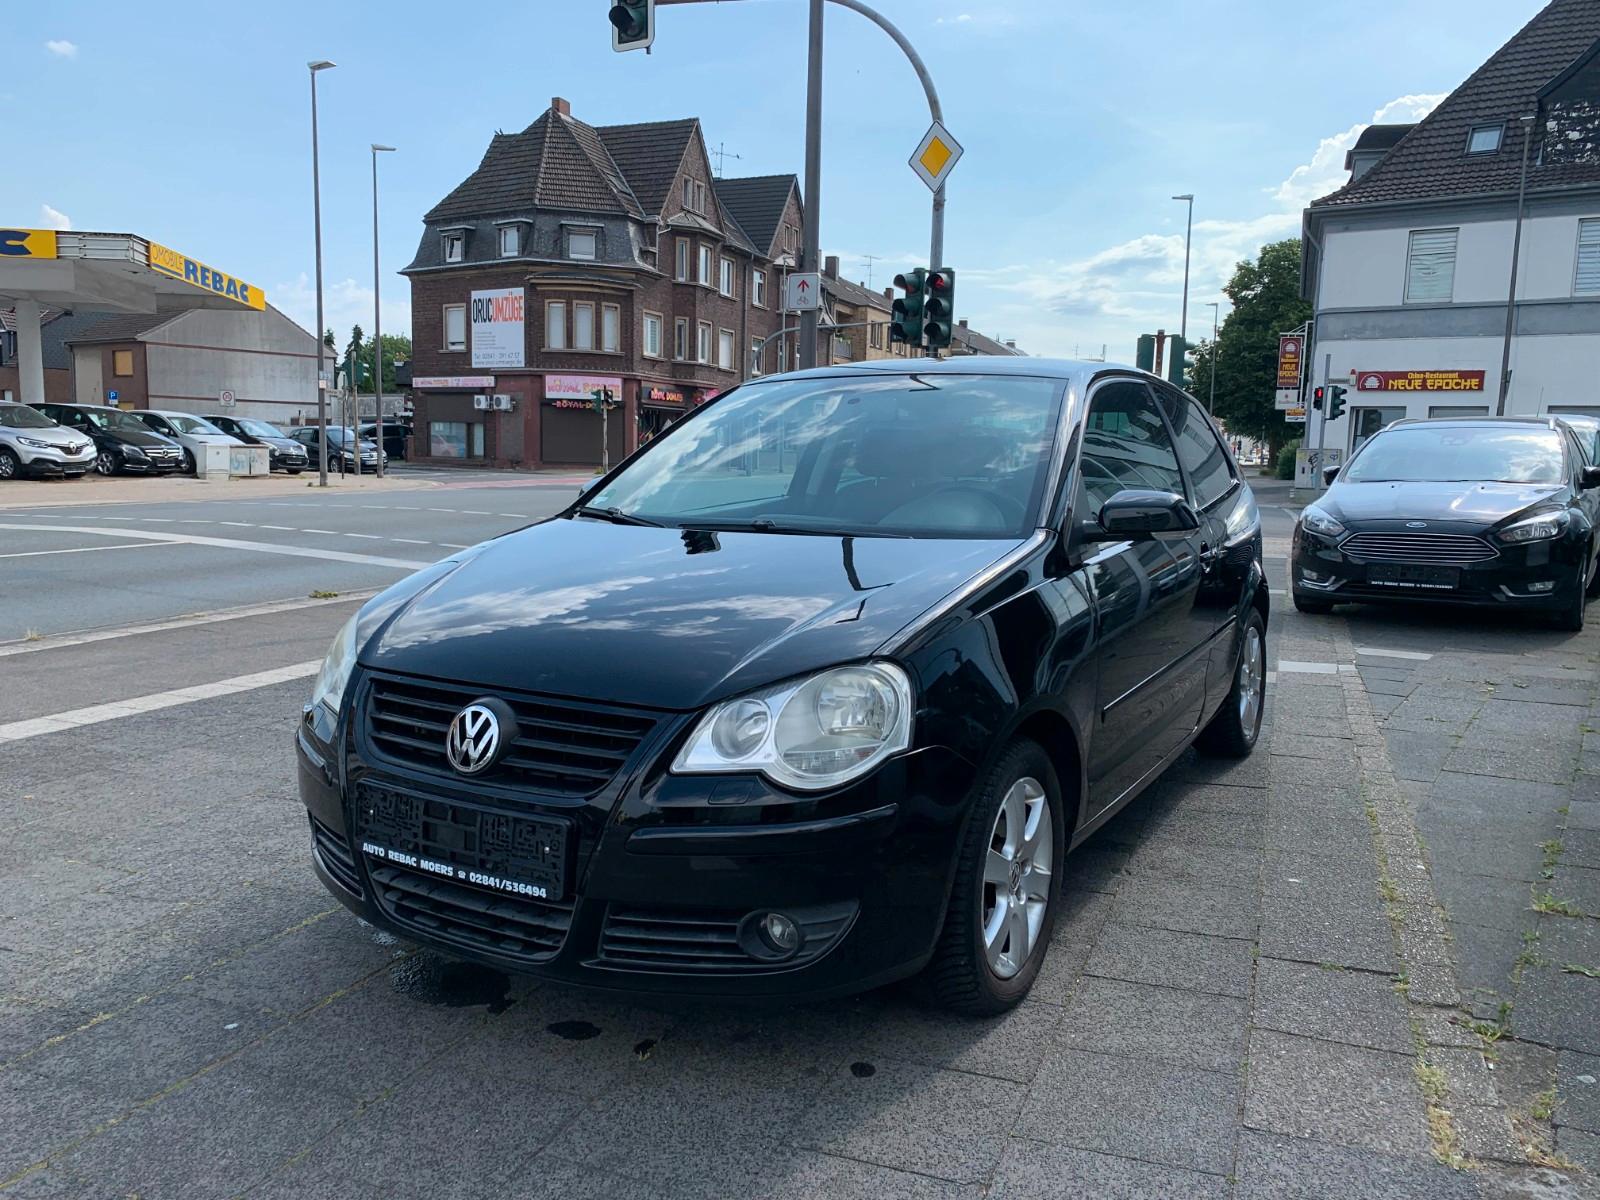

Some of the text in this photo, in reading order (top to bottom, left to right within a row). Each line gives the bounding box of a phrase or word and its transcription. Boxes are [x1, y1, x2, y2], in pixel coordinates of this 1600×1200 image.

[184, 258, 249, 303] REBAC
[1388, 379, 1479, 390] NEUE EPOCHE
[362, 842, 547, 898] AUTO REBAC MOERS 02841/536494
